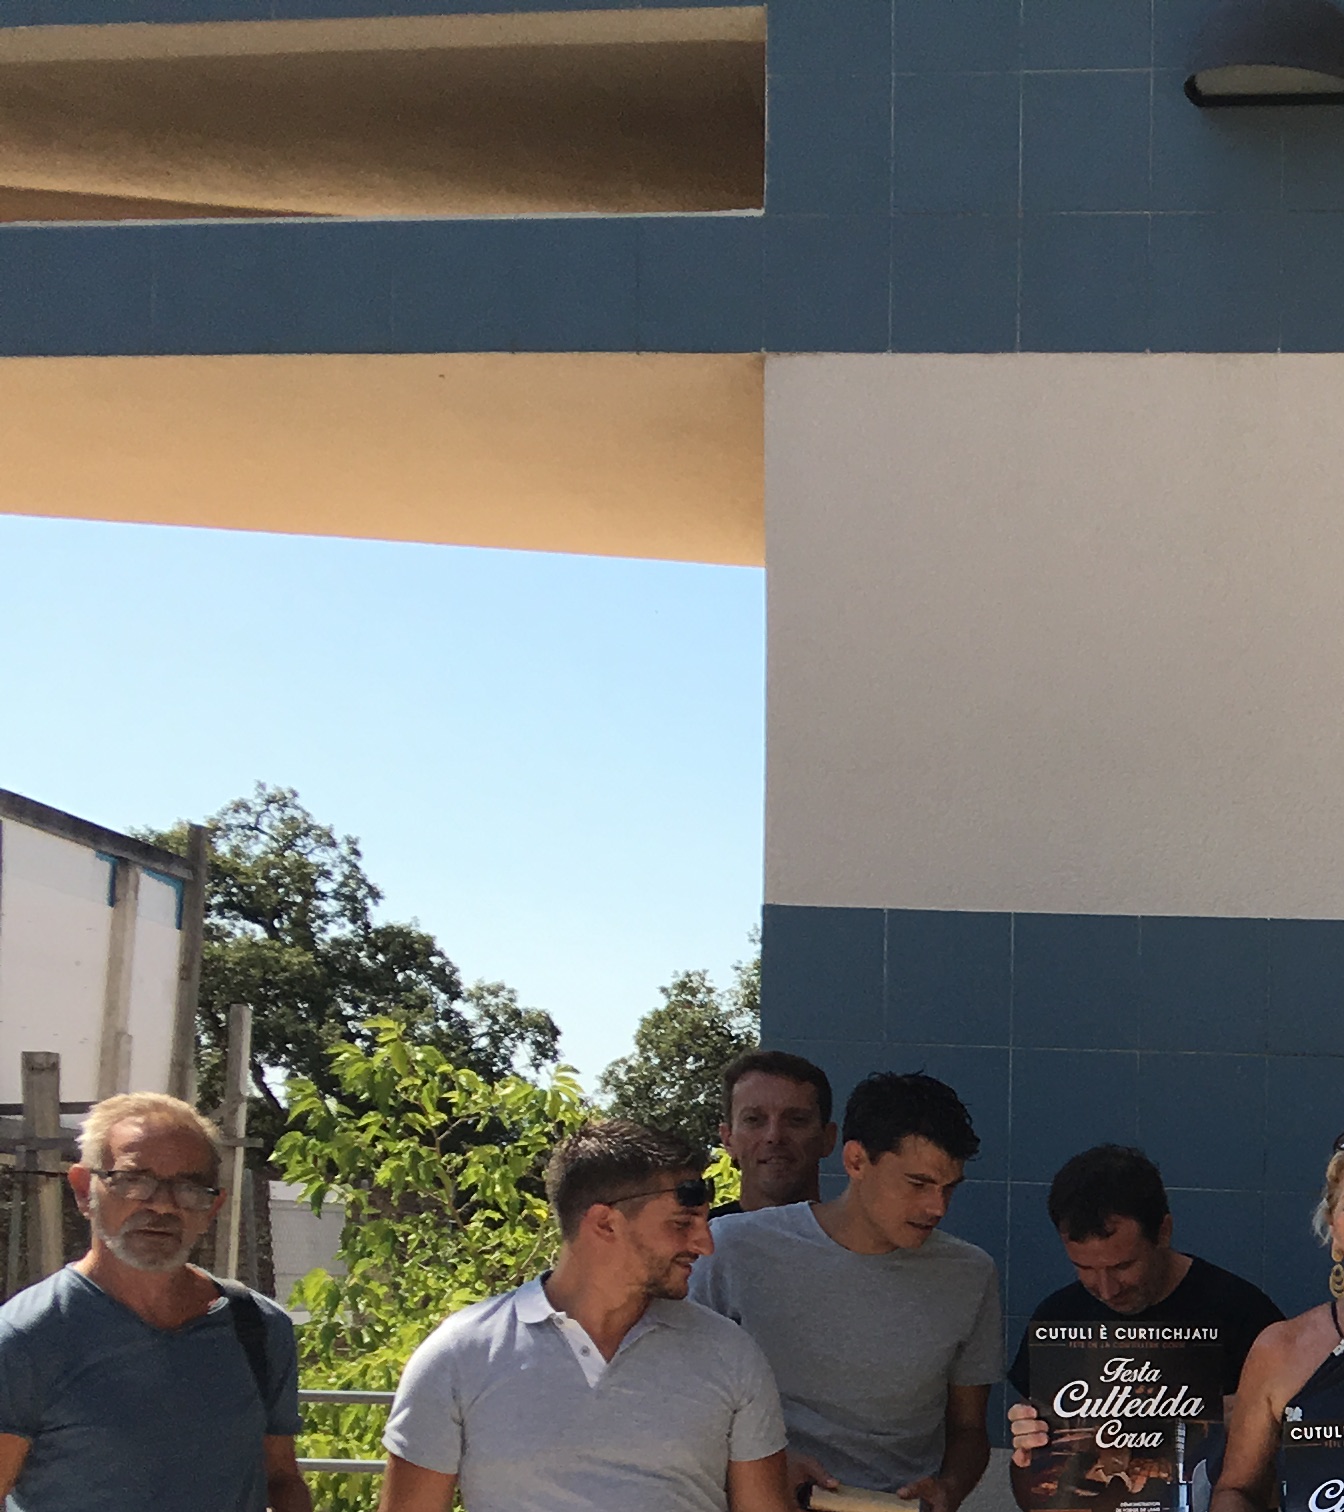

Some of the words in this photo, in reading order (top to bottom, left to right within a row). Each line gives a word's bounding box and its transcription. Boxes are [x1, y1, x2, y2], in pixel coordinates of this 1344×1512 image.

[1035, 1327, 1093, 1340] CUTULI
[1100, 1324, 1109, 1340] È
[1114, 1327, 1219, 1341] CURTICHJATU
[1099, 1357, 1162, 1383] Festa
[1053, 1380, 1205, 1418] Cultedda
[1095, 1419, 1165, 1449] Corsa
